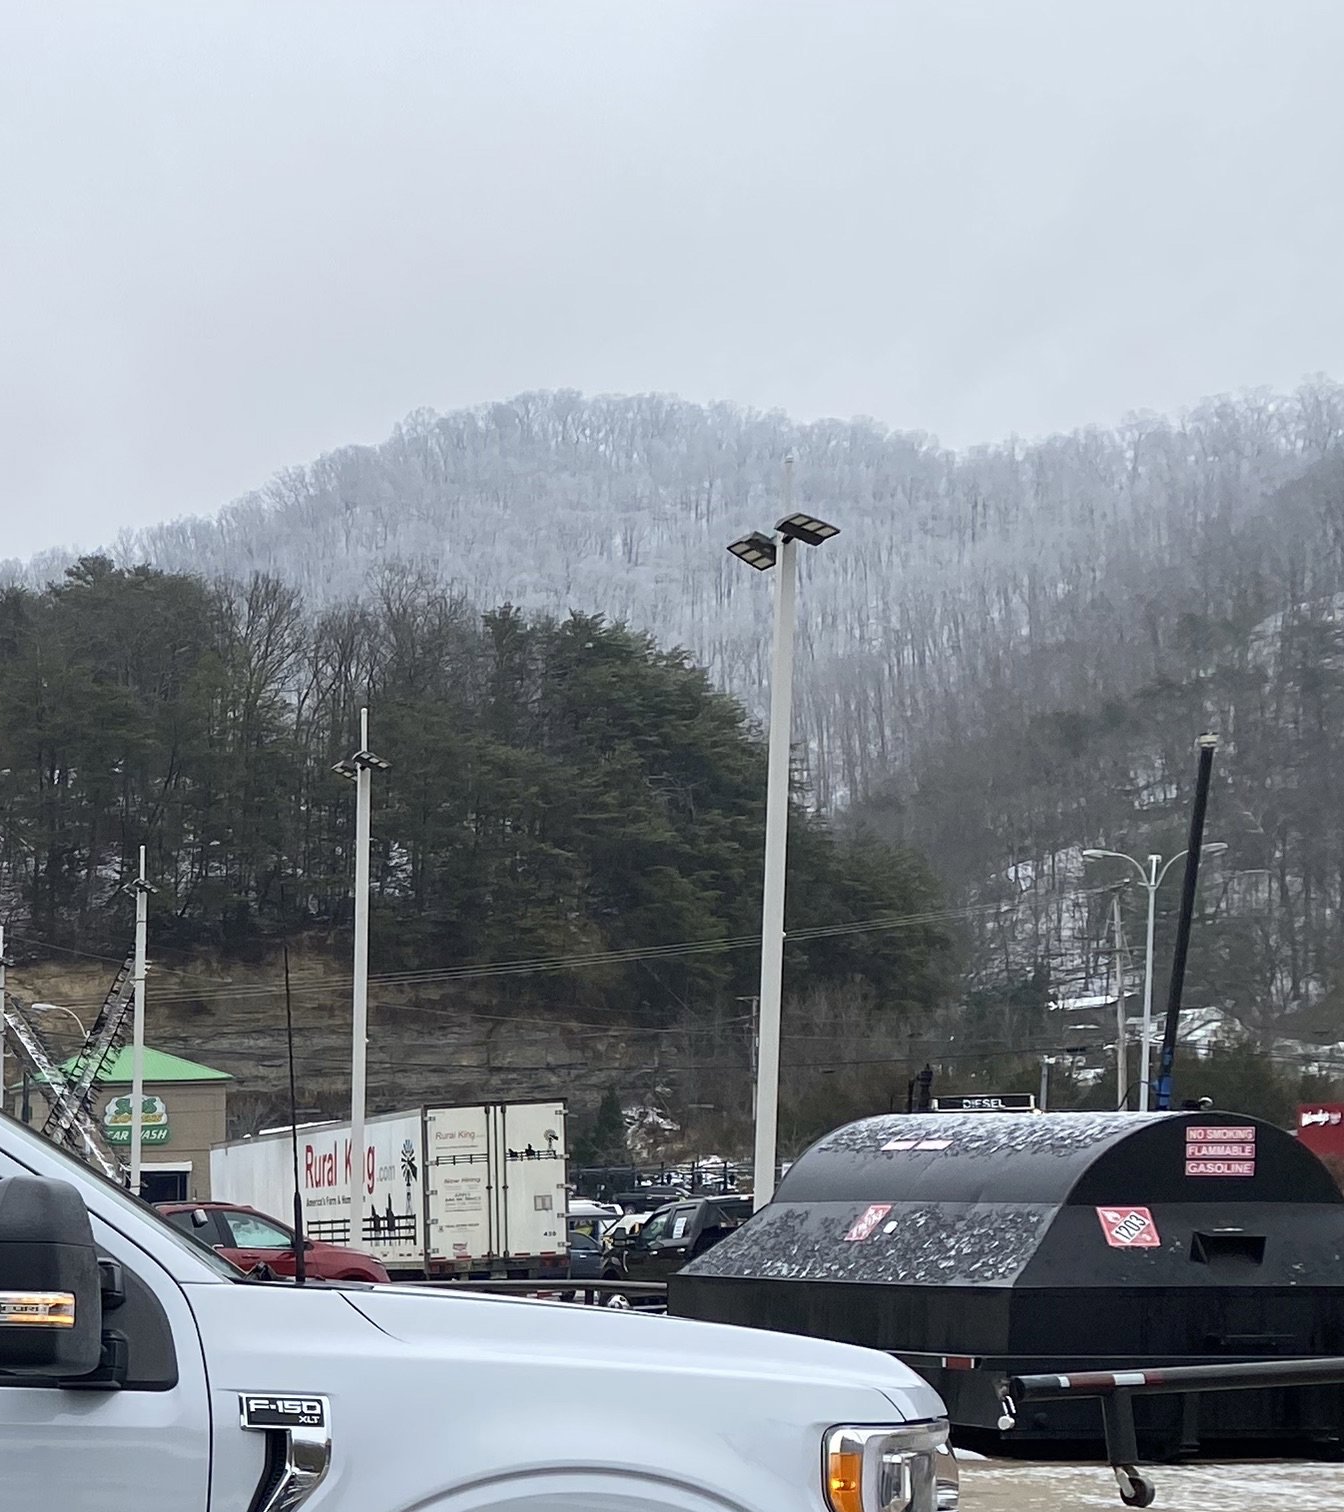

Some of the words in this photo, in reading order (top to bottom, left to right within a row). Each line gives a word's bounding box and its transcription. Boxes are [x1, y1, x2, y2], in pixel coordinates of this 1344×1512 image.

[1189, 1129, 1205, 1140] NO
[1206, 1129, 1253, 1140] SMOKING
[1188, 1145, 1253, 1156] FLAMMABLE
[305, 1140, 337, 1189] Rural
[345, 1138, 376, 1195] Kg
[1188, 1163, 1253, 1174] GASOLINE
[1114, 1214, 1146, 1240] 1203
[248, 1399, 321, 1415] F-150
[298, 1415, 320, 1424] XLT
